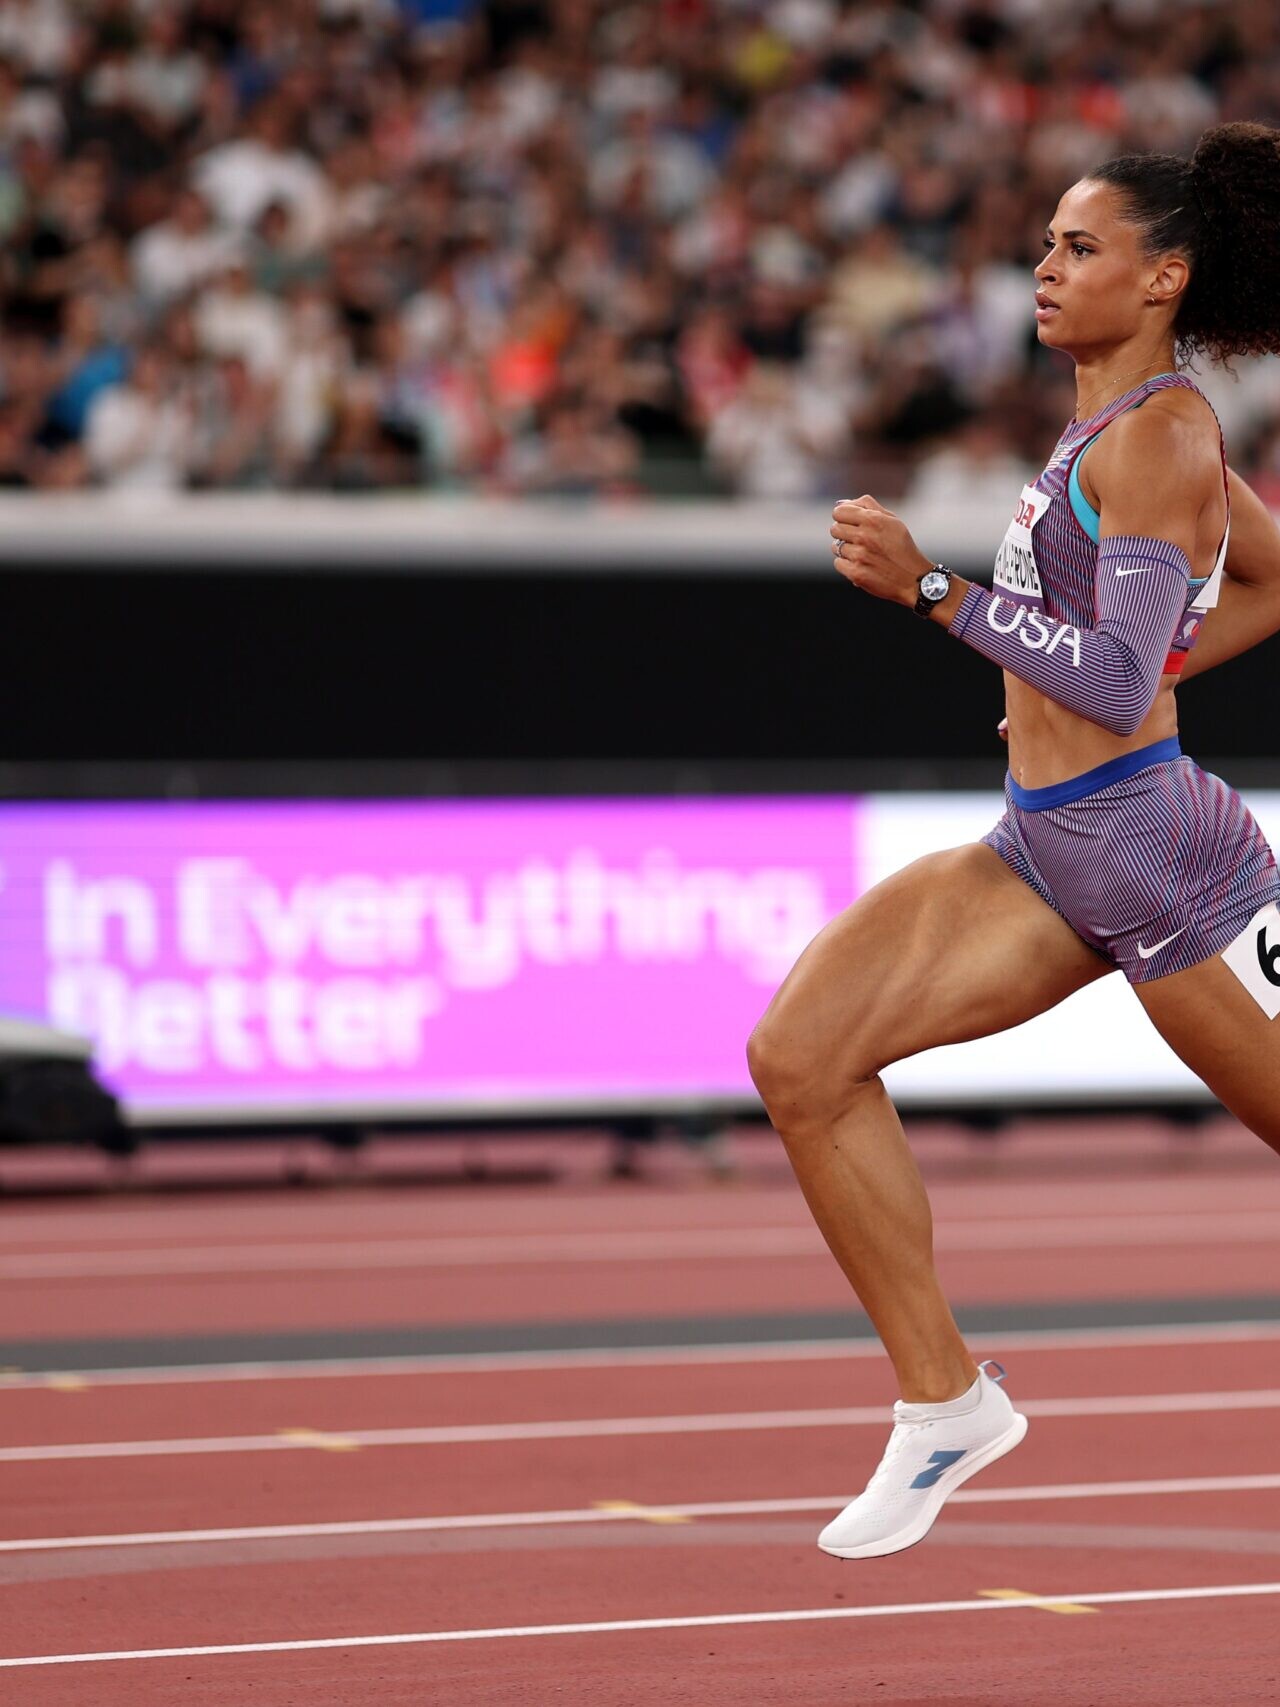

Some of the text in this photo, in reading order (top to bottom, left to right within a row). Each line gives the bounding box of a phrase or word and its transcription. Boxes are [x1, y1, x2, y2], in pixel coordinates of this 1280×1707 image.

[987, 595, 1081, 667] USA
[46, 847, 827, 988] In Everything
